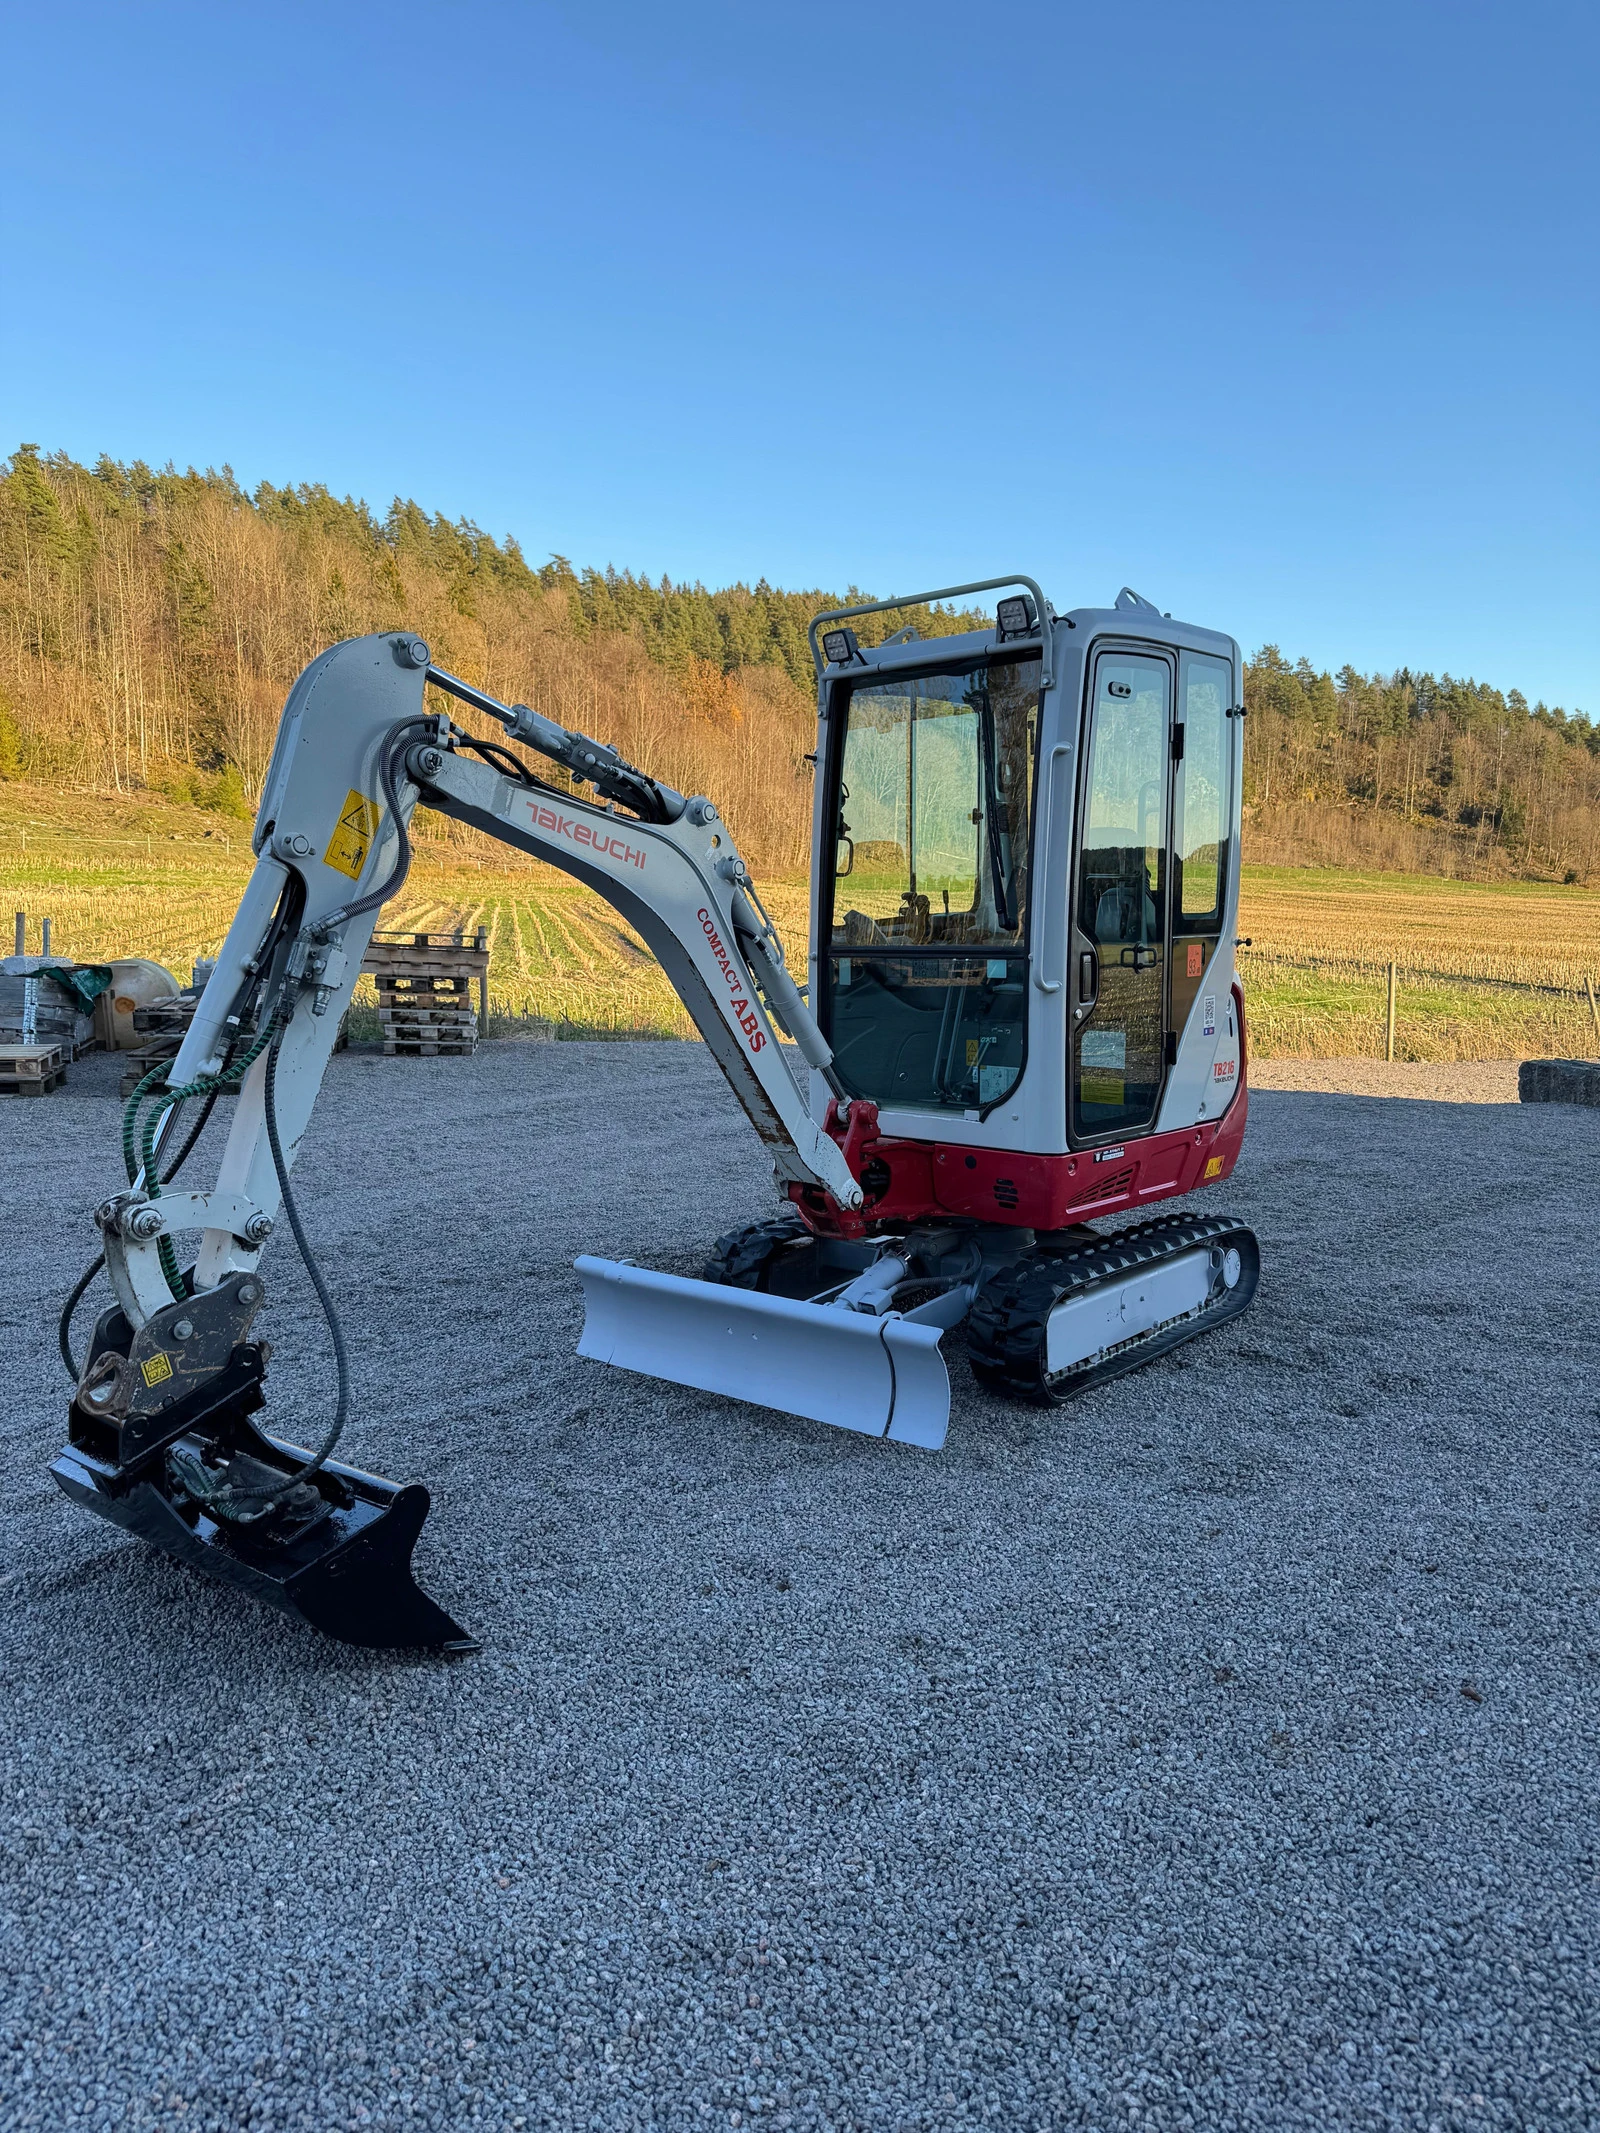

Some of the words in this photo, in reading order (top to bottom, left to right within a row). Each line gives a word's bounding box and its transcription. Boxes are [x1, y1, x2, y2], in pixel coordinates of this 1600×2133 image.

[697, 907, 742, 993] COMPACT
[730, 998, 767, 1053] ABS
[1213, 1060, 1235, 1077] TB216
